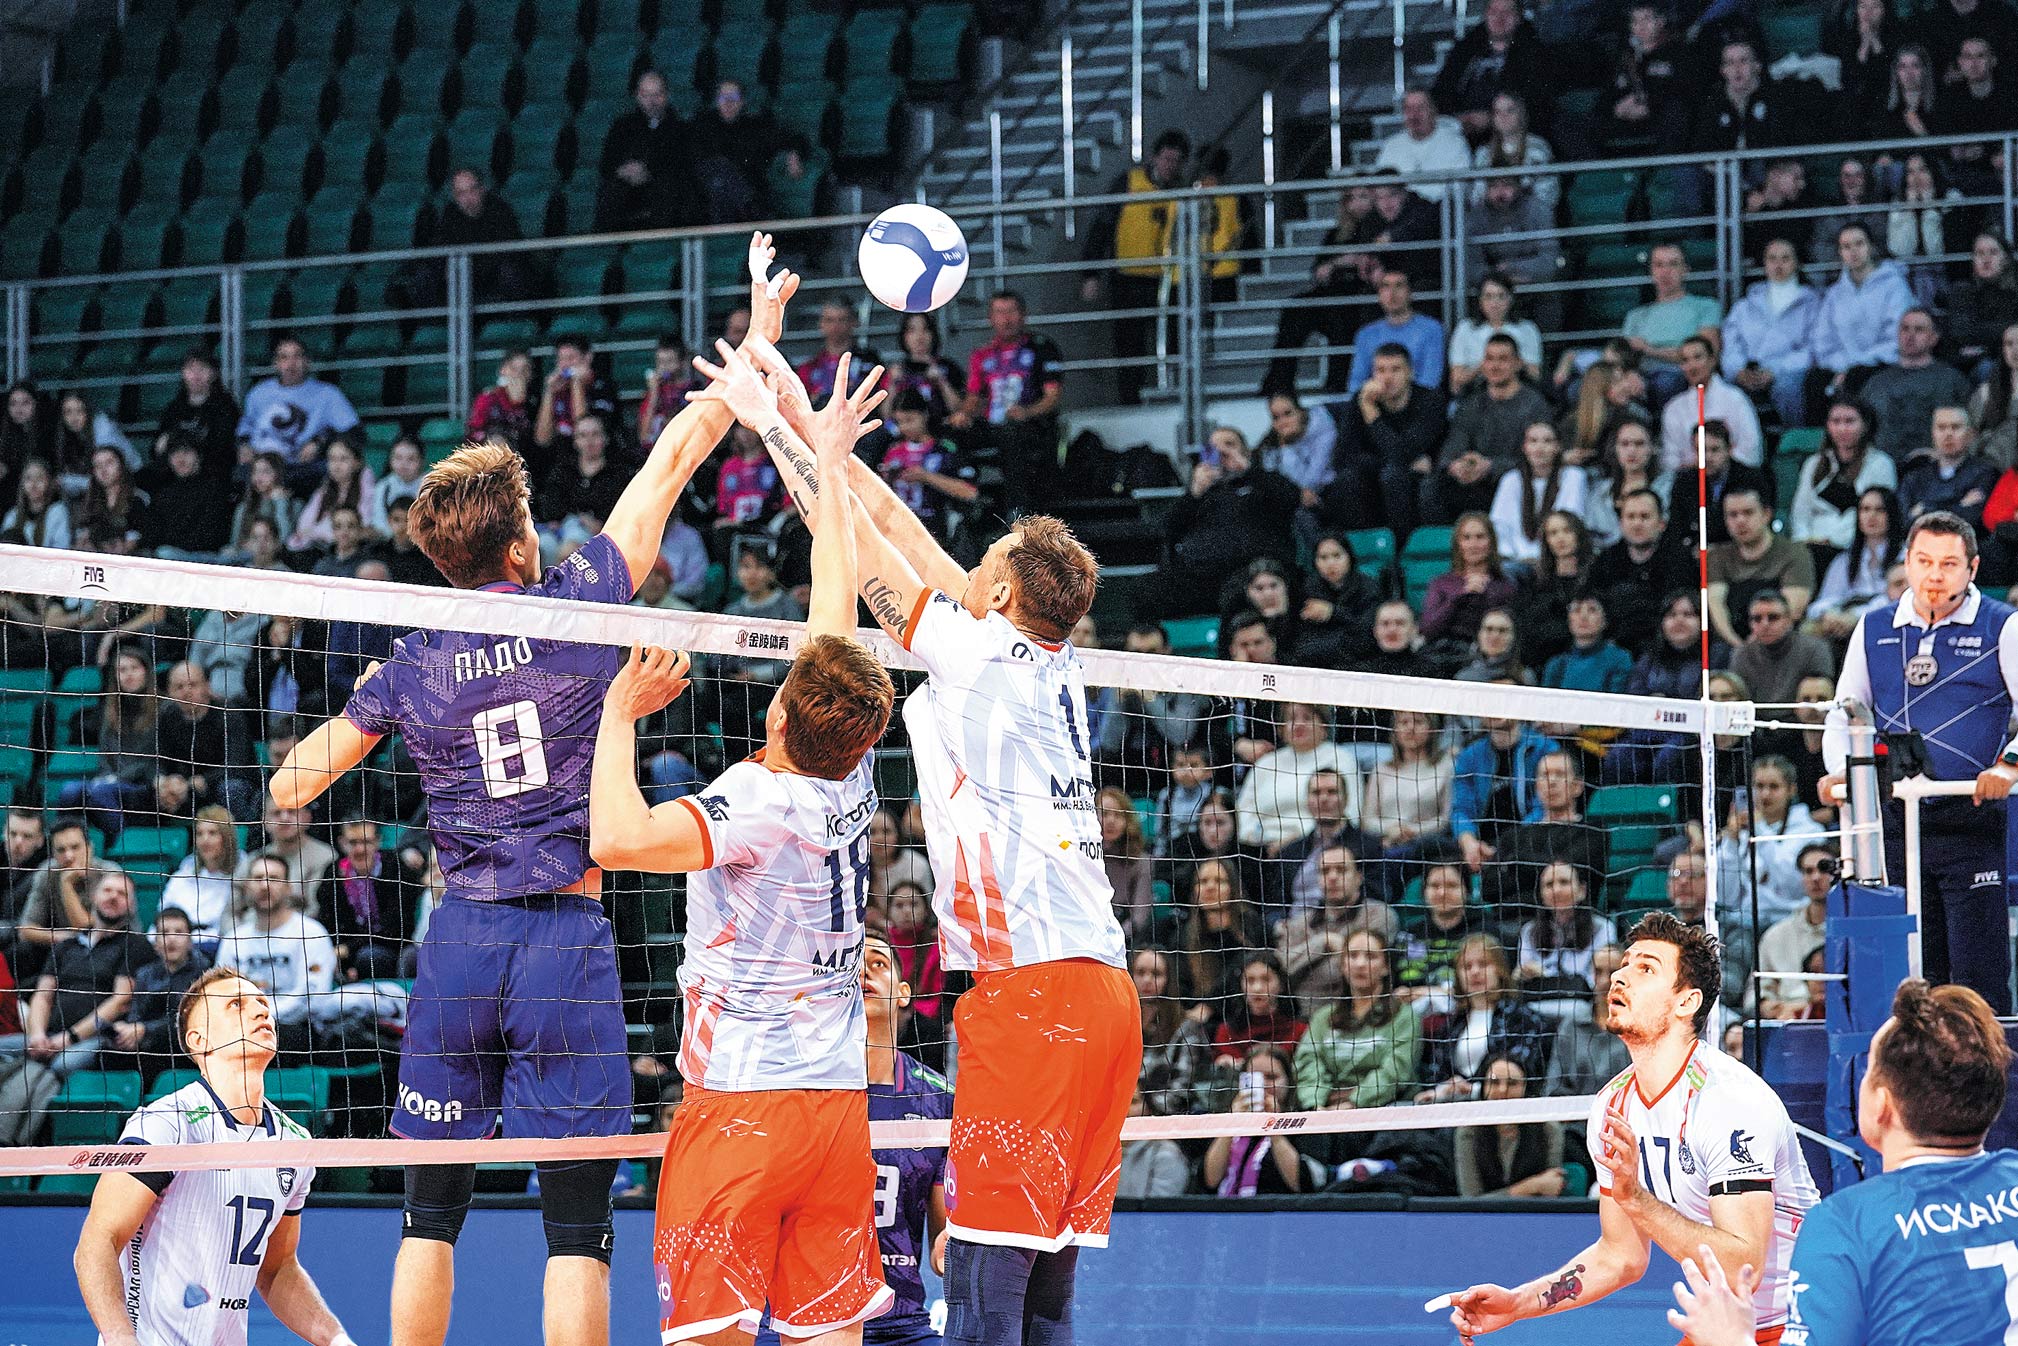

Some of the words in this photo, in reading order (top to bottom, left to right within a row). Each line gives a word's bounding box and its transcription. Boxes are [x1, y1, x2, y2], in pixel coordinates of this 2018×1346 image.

[84, 565, 106, 583] FIVB
[454, 636, 534, 683] ПАДО
[748, 632, 790, 651] 金陵体育
[472, 700, 549, 799] 8
[824, 823, 871, 932] 18
[88, 1152, 147, 1167] 金陵体育
[1639, 1136, 1677, 1204] 17
[225, 1195, 275, 1266] 12
[219, 1298, 249, 1311] НОВ
